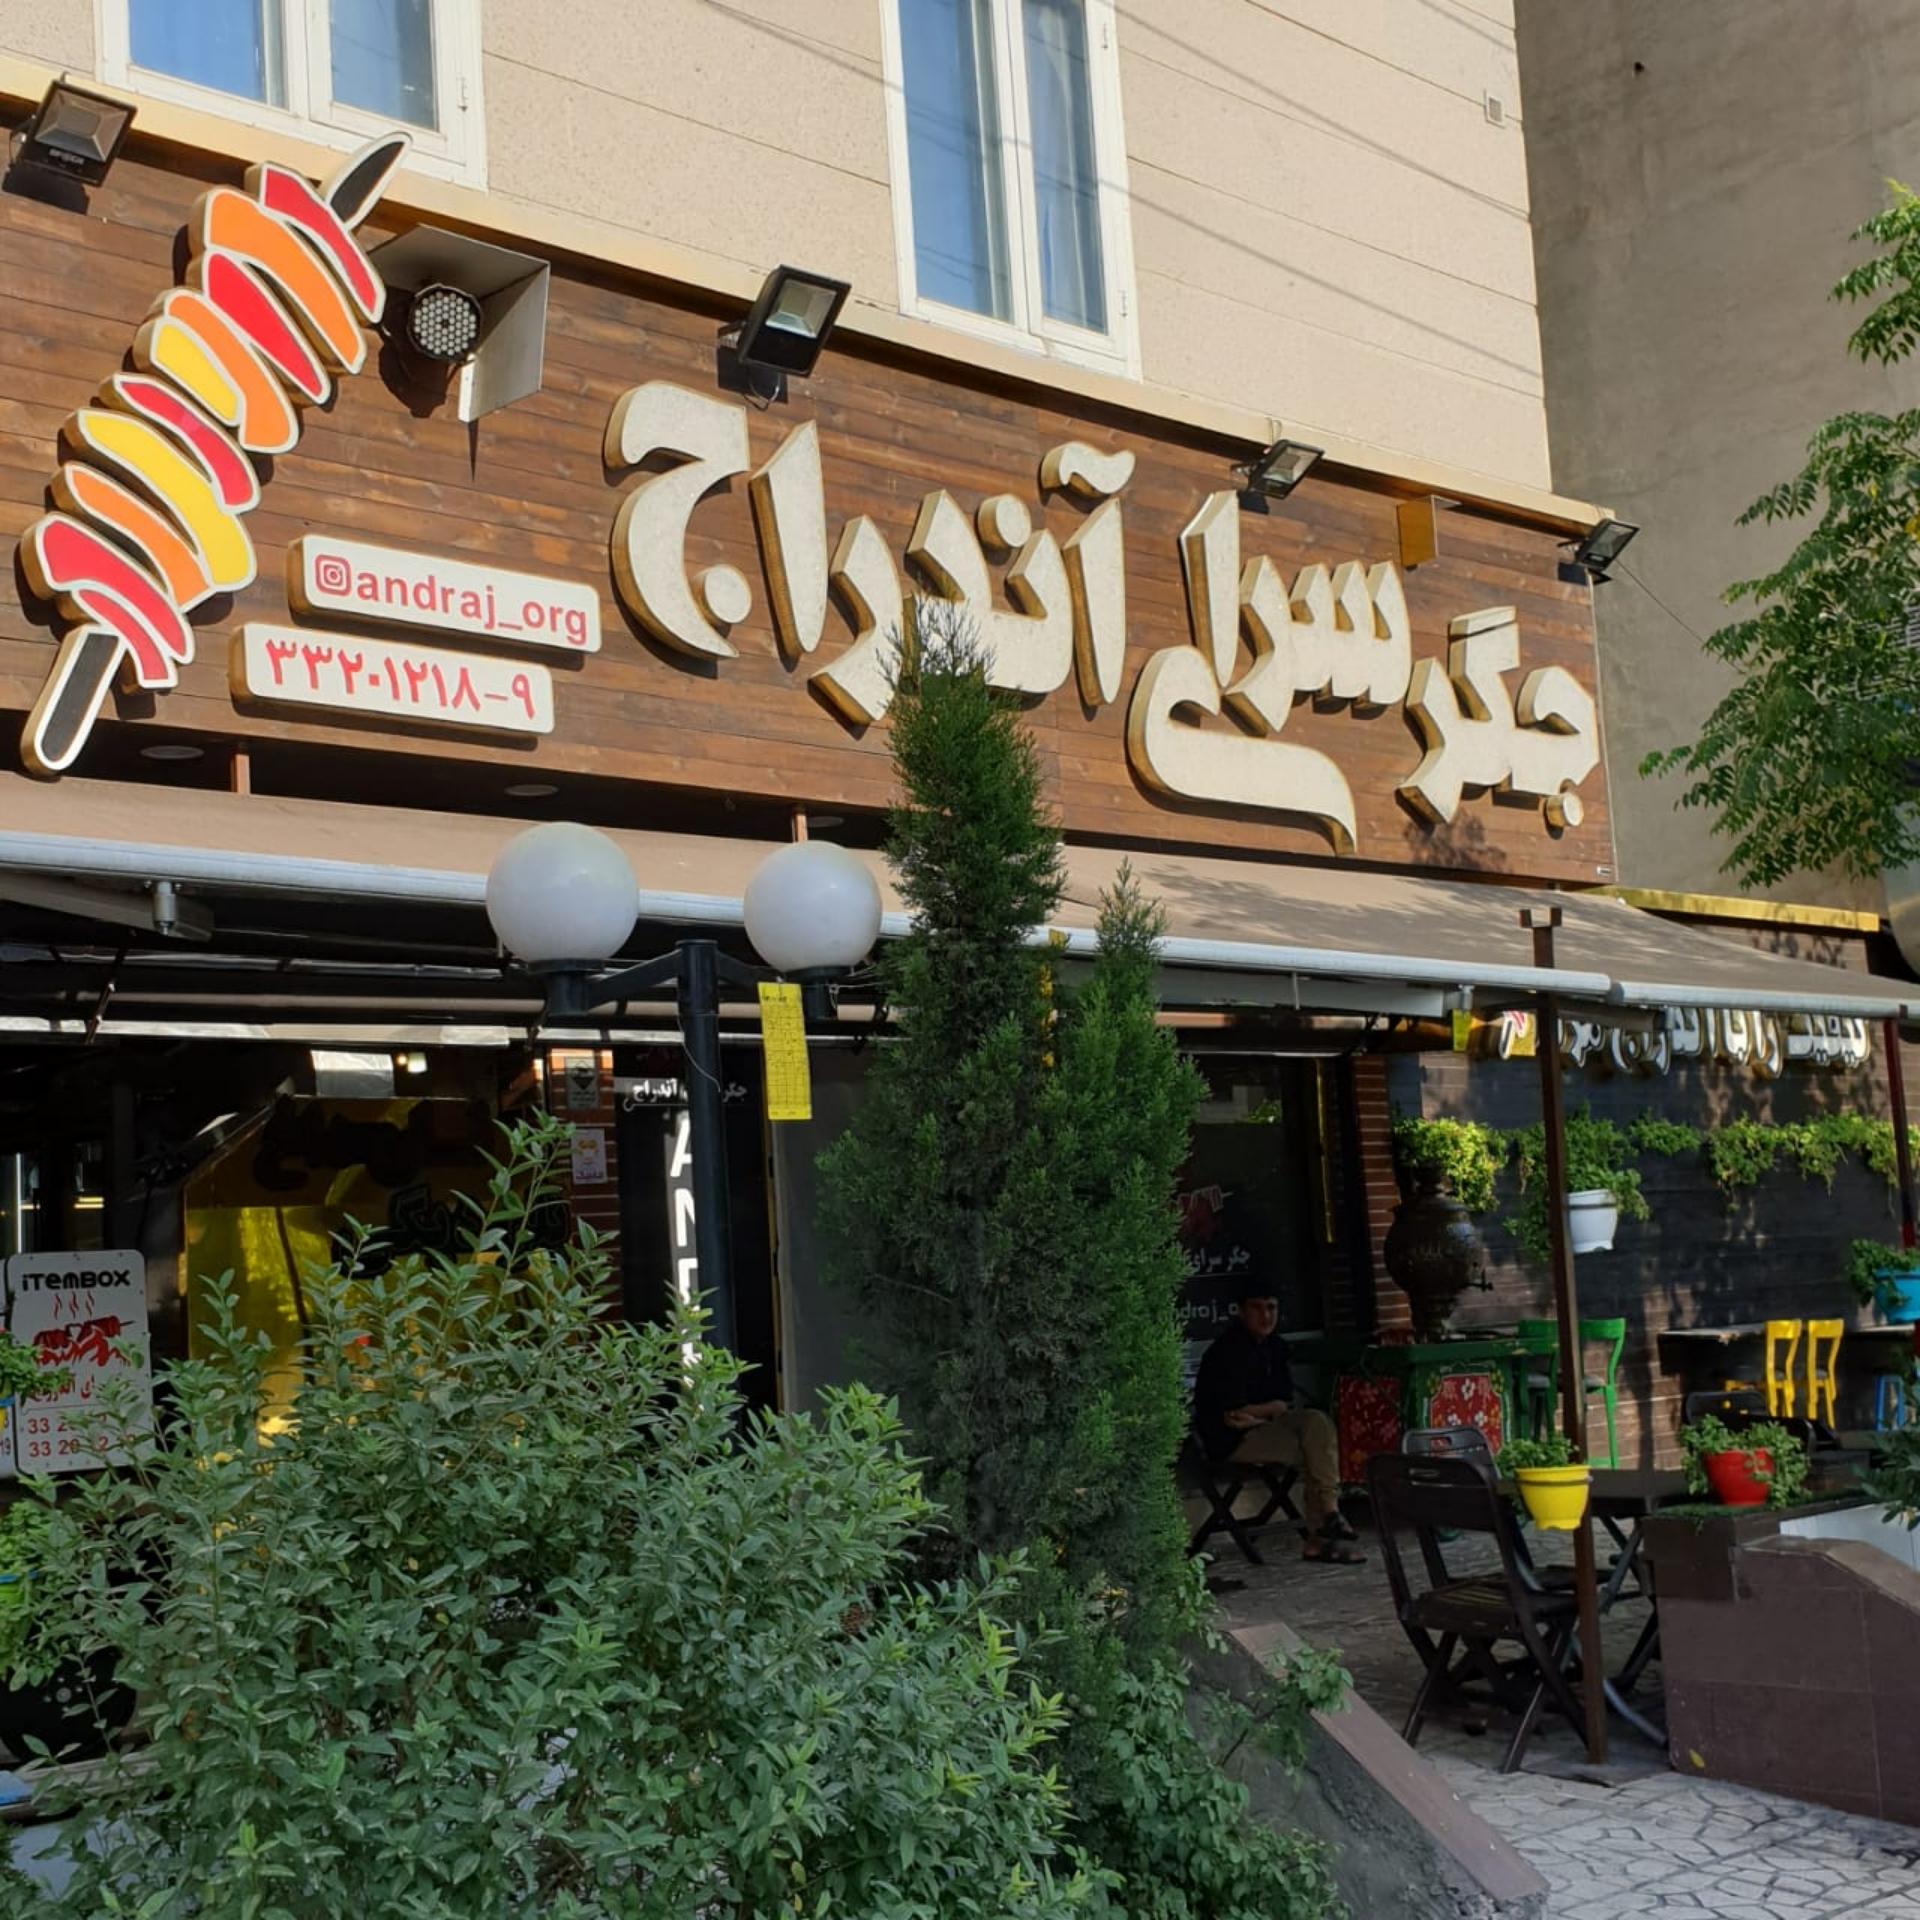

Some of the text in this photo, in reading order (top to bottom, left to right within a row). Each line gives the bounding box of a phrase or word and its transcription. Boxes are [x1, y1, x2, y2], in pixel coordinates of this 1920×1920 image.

[357, 575, 586, 645] andraj_org
[28, 1417, 50, 1434] 33
[29, 1440, 51, 1457] 33
